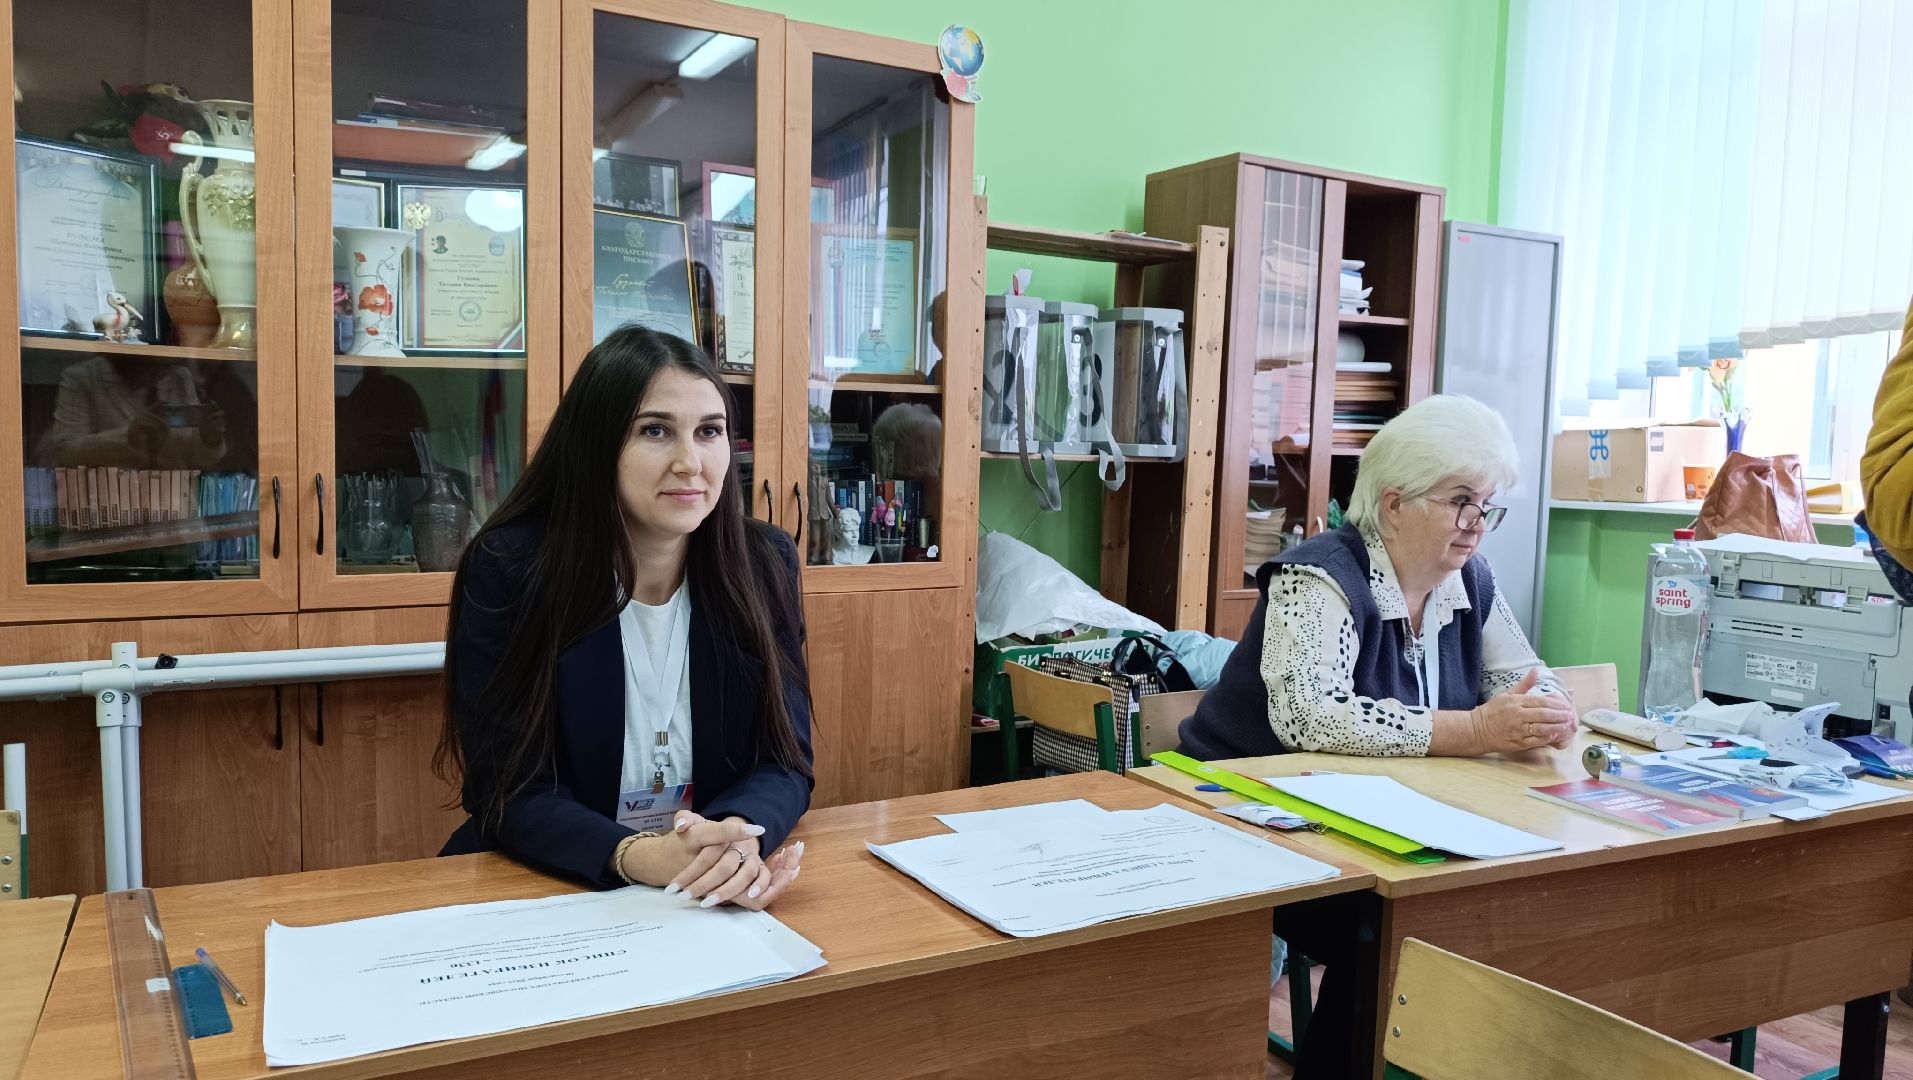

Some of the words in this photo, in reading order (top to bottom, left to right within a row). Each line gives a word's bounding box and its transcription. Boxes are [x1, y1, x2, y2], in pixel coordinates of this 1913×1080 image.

[1658, 588, 1688, 598] saint
[1655, 597, 1691, 609] spring
[556, 949, 627, 965] СПИСОК
[420, 961, 550, 985] ИЗБИРАТЕЛЕЙ
